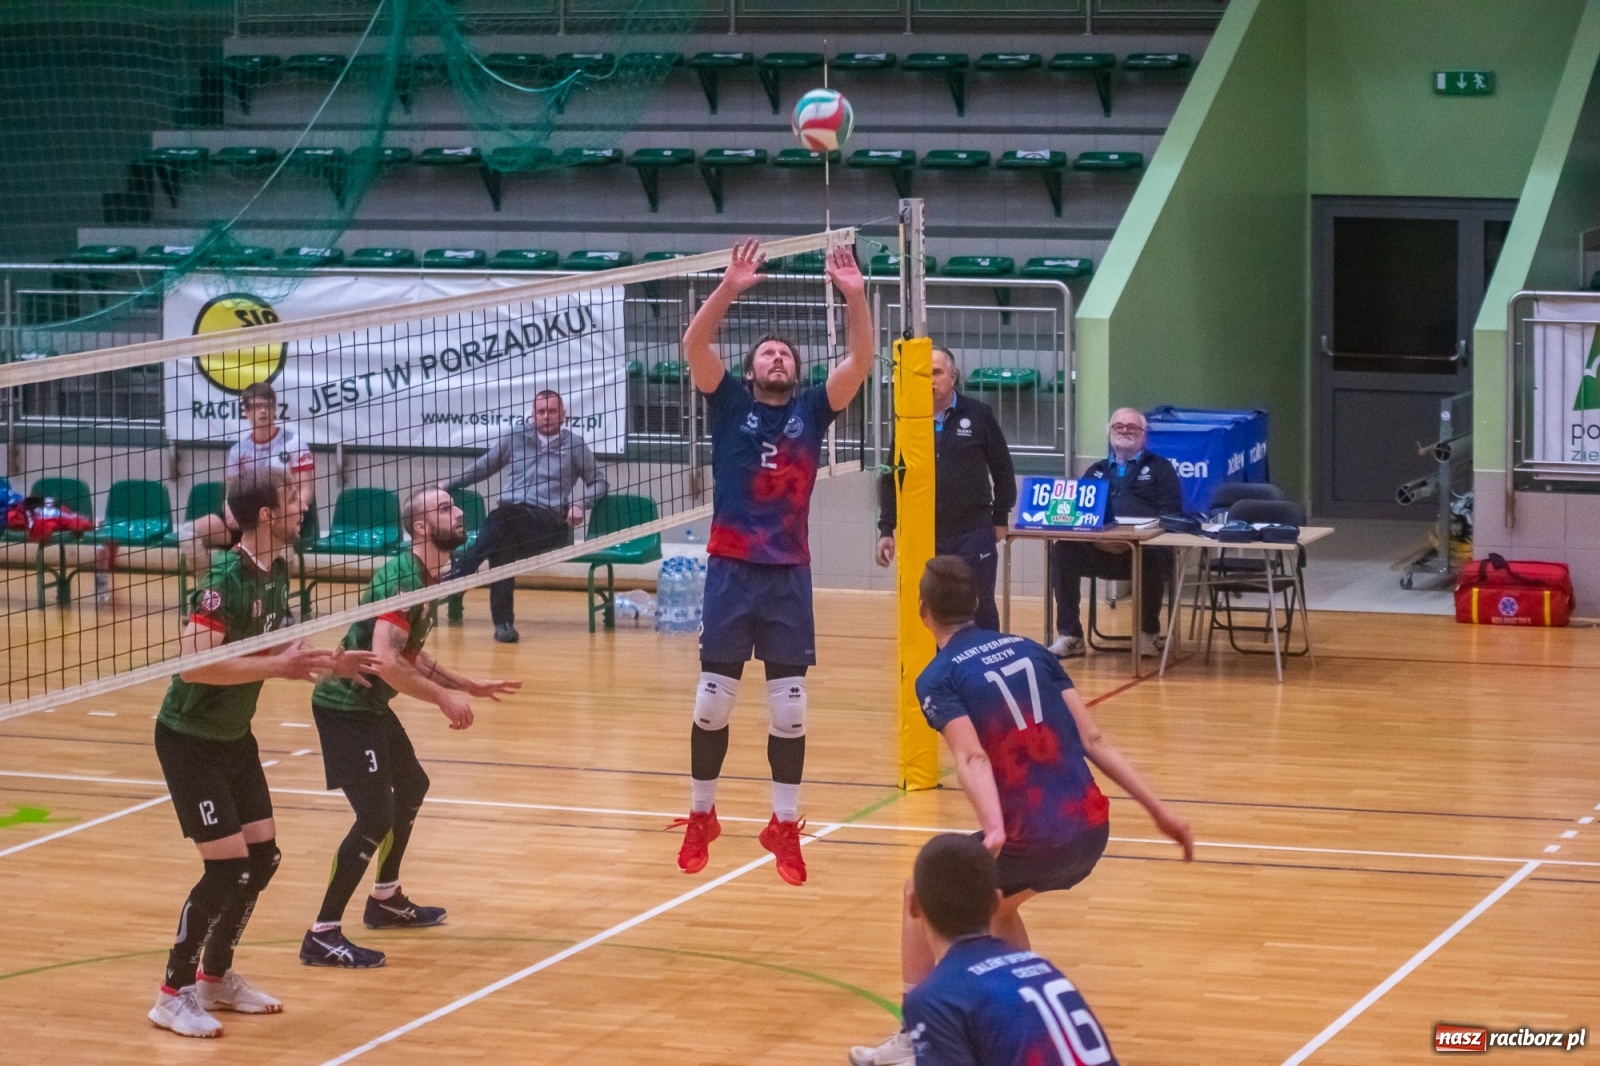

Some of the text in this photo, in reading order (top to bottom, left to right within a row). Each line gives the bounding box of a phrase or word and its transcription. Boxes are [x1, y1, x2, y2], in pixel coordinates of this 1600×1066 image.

[308, 306, 597, 414] JEST W PORZĄDKU!
[761, 441, 778, 470] 2
[1032, 483, 1051, 506] 16
[1079, 485, 1097, 508] 18
[951, 646, 981, 665] TALENT
[984, 657, 1043, 731] 17
[364, 750, 378, 773] 3
[199, 800, 218, 826] 12
[1018, 978, 1111, 1066] 16
